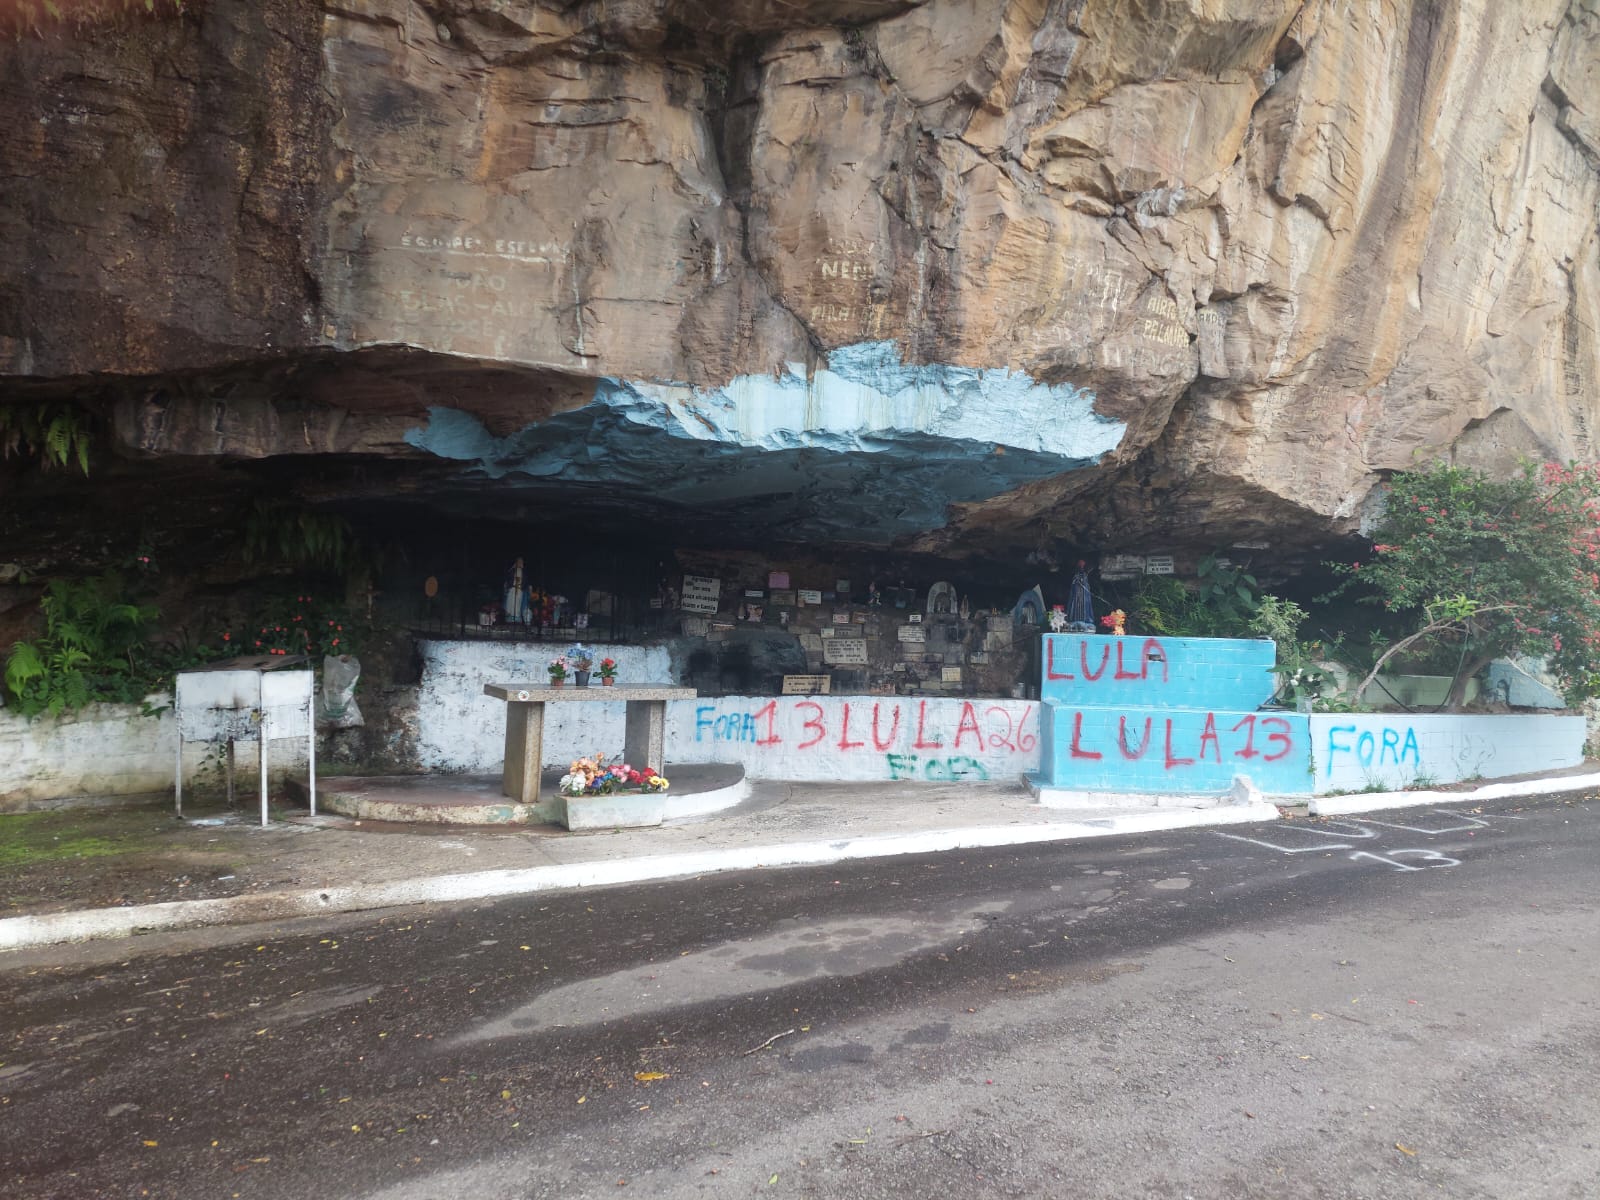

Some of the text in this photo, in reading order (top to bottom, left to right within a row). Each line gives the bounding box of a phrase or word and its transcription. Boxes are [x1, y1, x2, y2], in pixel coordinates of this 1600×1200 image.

[1047, 638, 1168, 682] LULA
[696, 706, 757, 743] FORA
[1326, 725, 1420, 778] FORA
[1349, 849, 1463, 872] 13
